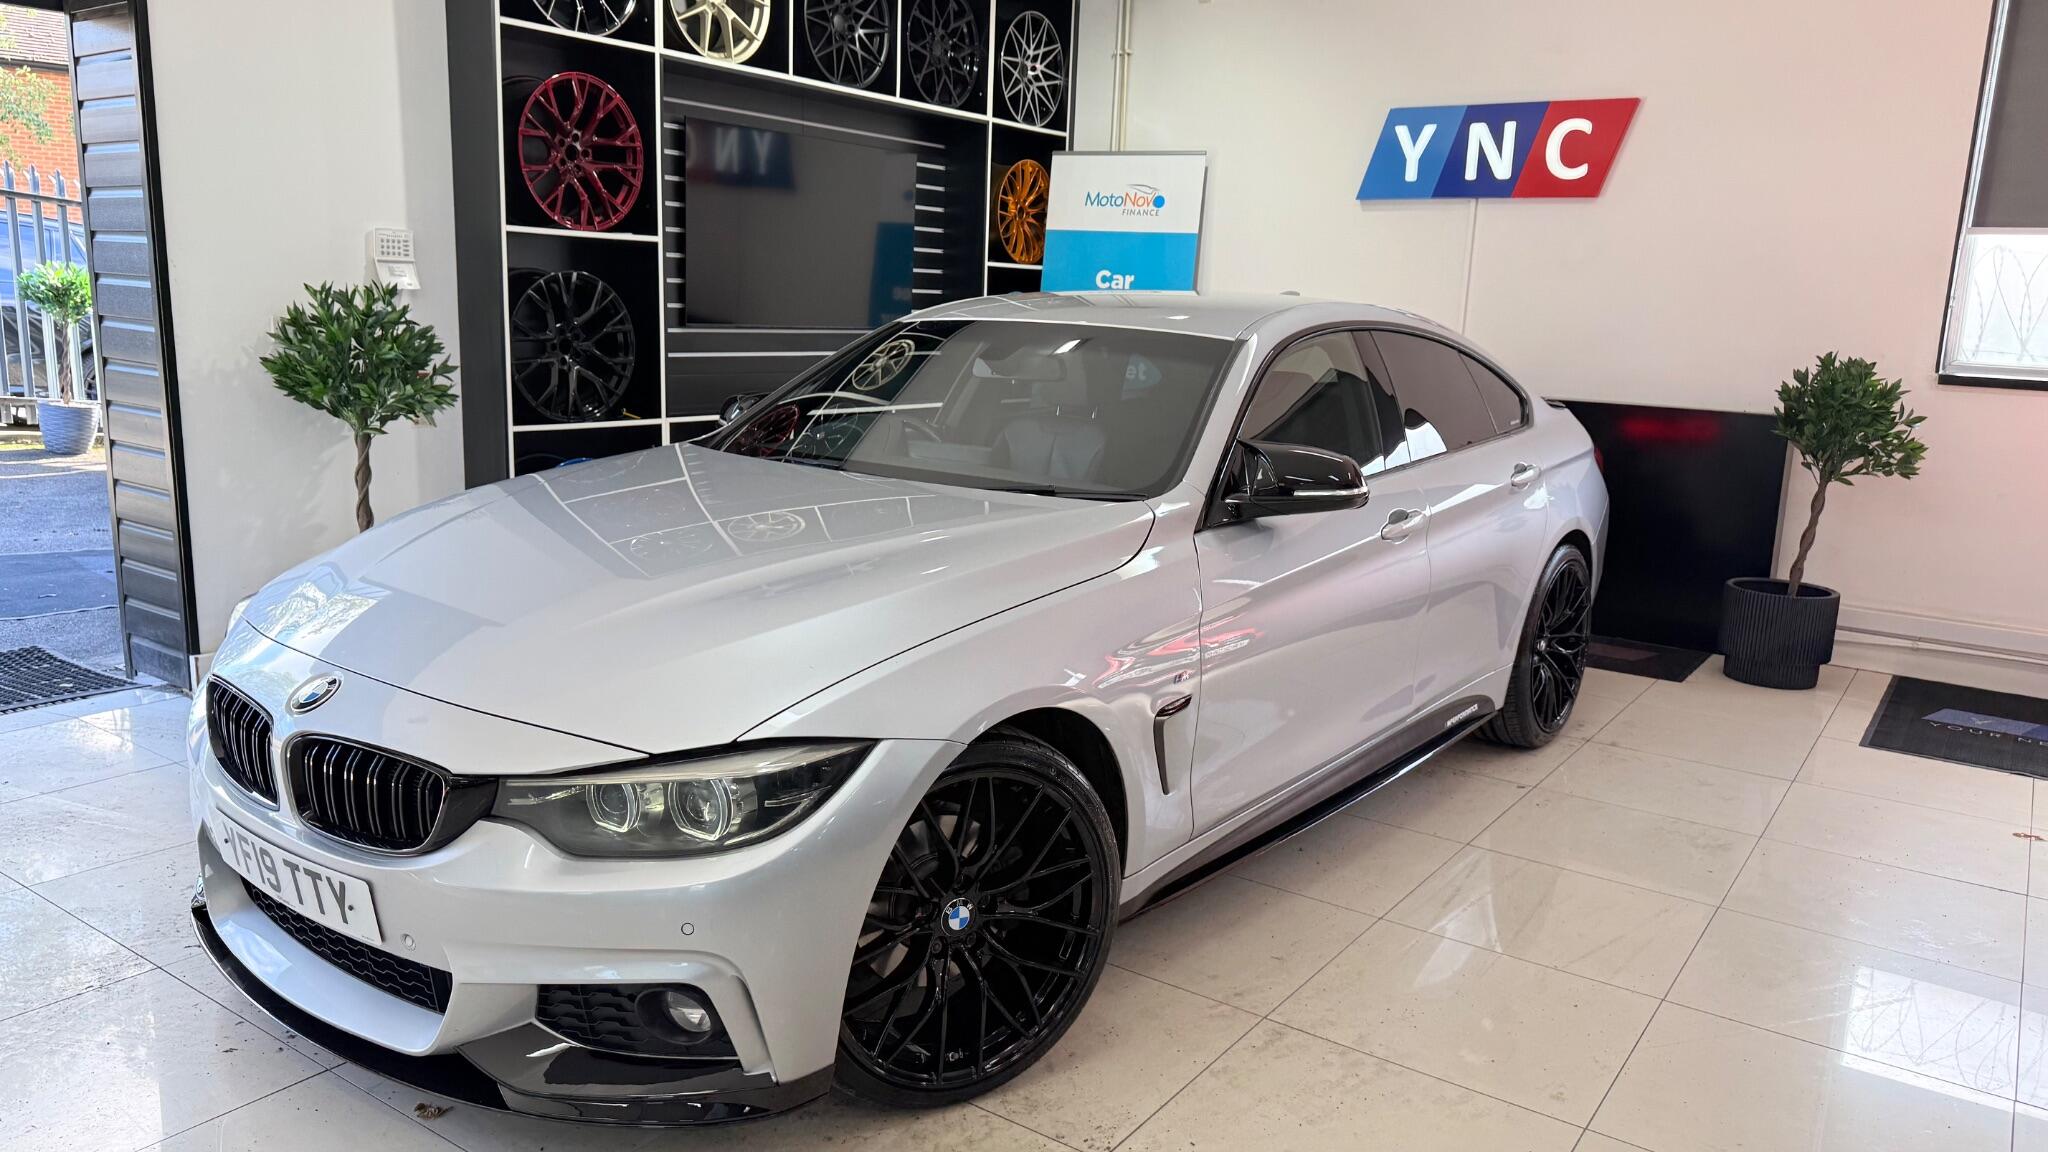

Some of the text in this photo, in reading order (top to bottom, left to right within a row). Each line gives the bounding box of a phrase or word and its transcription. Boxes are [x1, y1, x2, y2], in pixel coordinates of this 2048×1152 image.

[1394, 117, 1593, 182] YNC
[1084, 191, 1166, 209] MotoNovo
[1121, 208, 1160, 217] FINANCE
[1095, 269, 1135, 290] Car
[1928, 721, 2001, 738] YOUR
[223, 822, 349, 925] YF19 TTY
